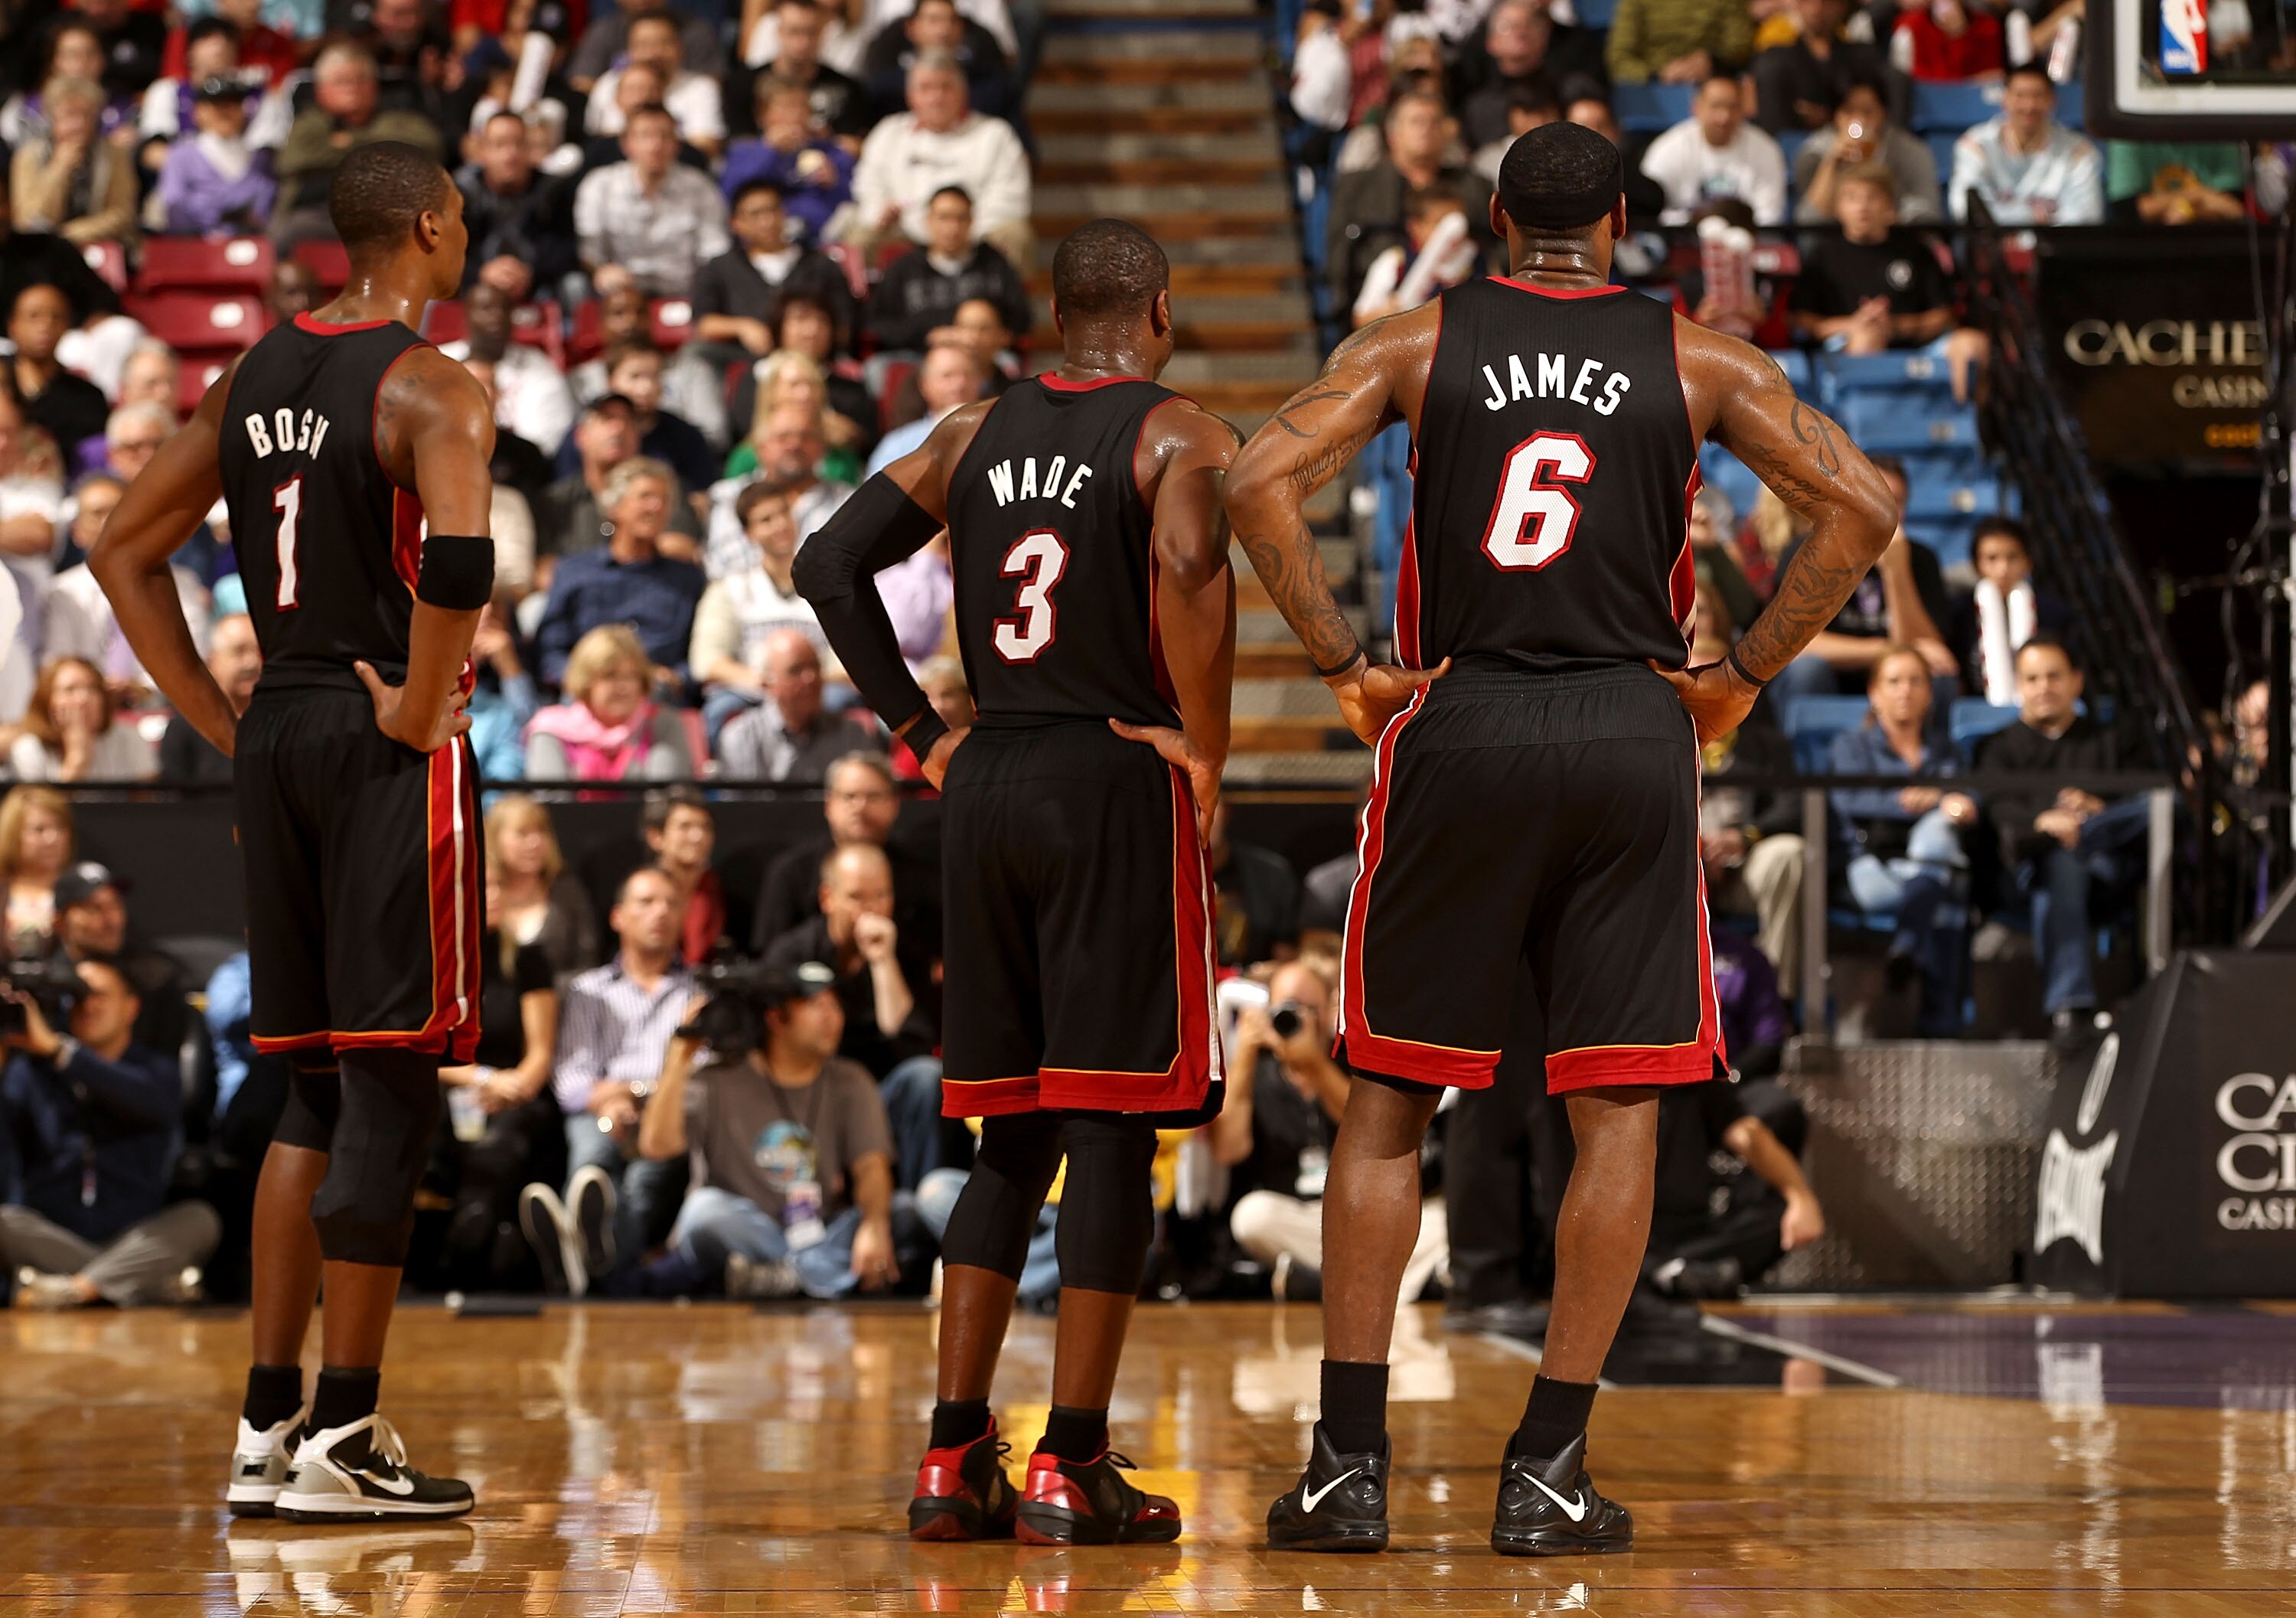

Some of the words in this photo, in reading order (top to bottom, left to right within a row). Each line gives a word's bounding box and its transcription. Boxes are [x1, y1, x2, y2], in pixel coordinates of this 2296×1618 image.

[245, 407, 330, 460] BOSH
[1482, 352, 1631, 416] JAMES
[987, 455, 1093, 509] WADE
[1480, 430, 1597, 572] 6
[272, 472, 304, 612] 1
[992, 527, 1071, 664] 3
